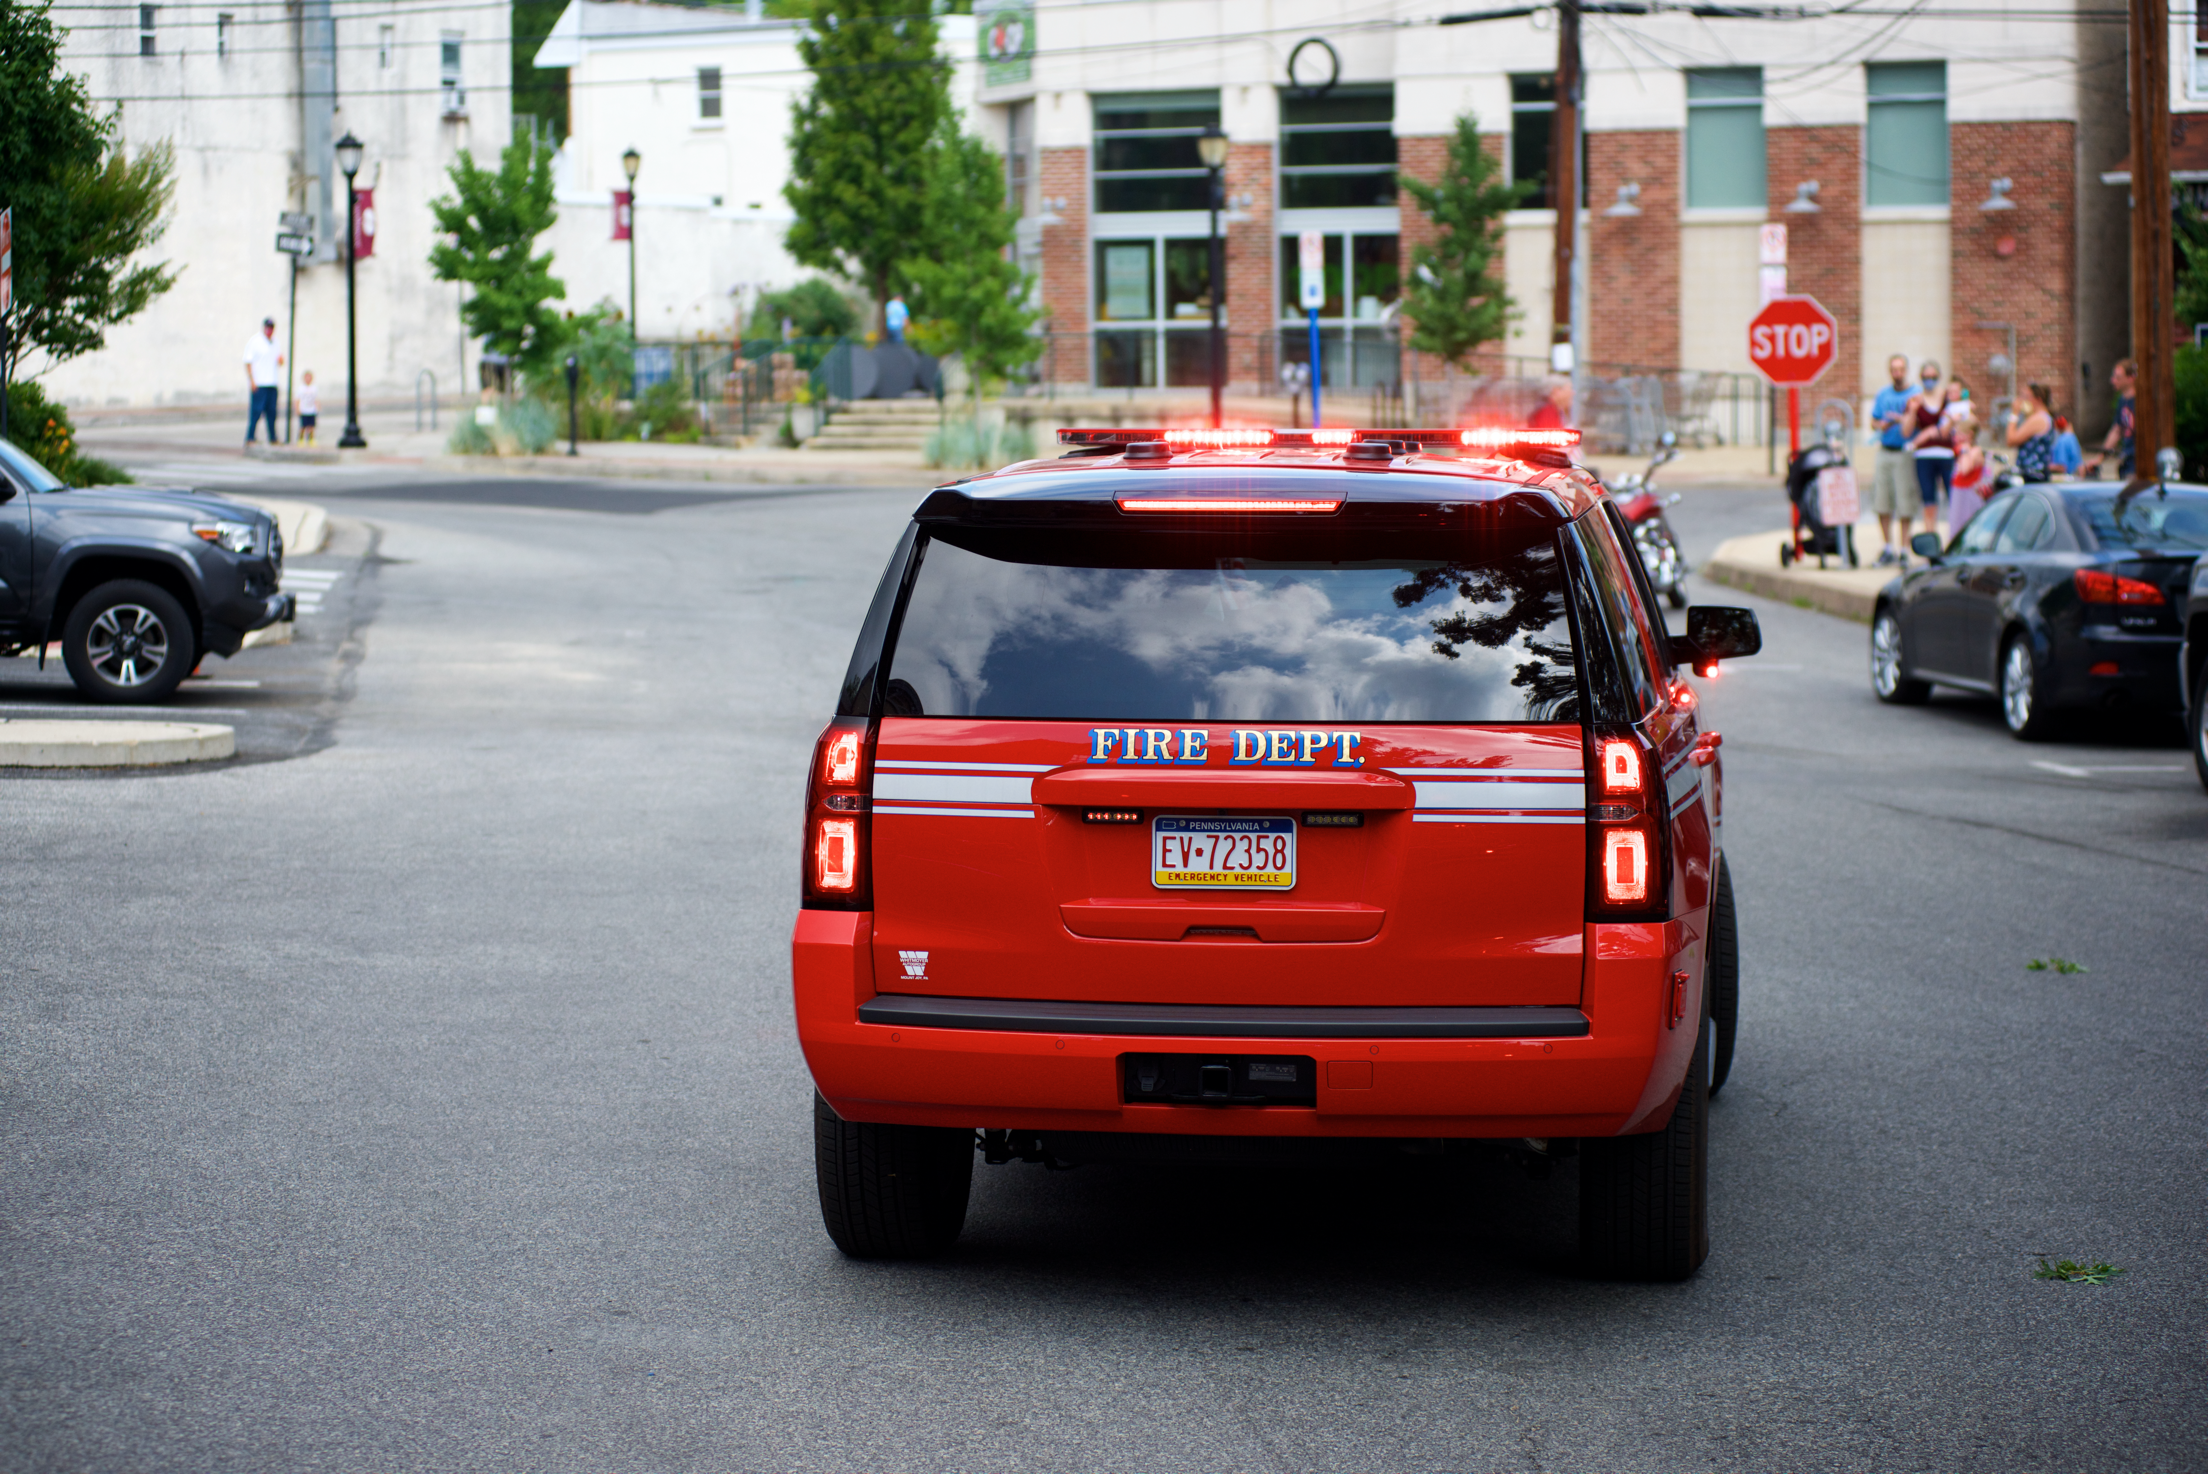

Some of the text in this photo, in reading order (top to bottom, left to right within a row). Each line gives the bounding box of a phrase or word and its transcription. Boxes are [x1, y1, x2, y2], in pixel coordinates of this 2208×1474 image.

[1753, 323, 1831, 360] STOP
[1088, 728, 1367, 766] FIRE DEPT.
[1189, 821, 1260, 831] PENNSYLVANIA
[1168, 872, 1280, 883] EMERGENCY VEHICLE
